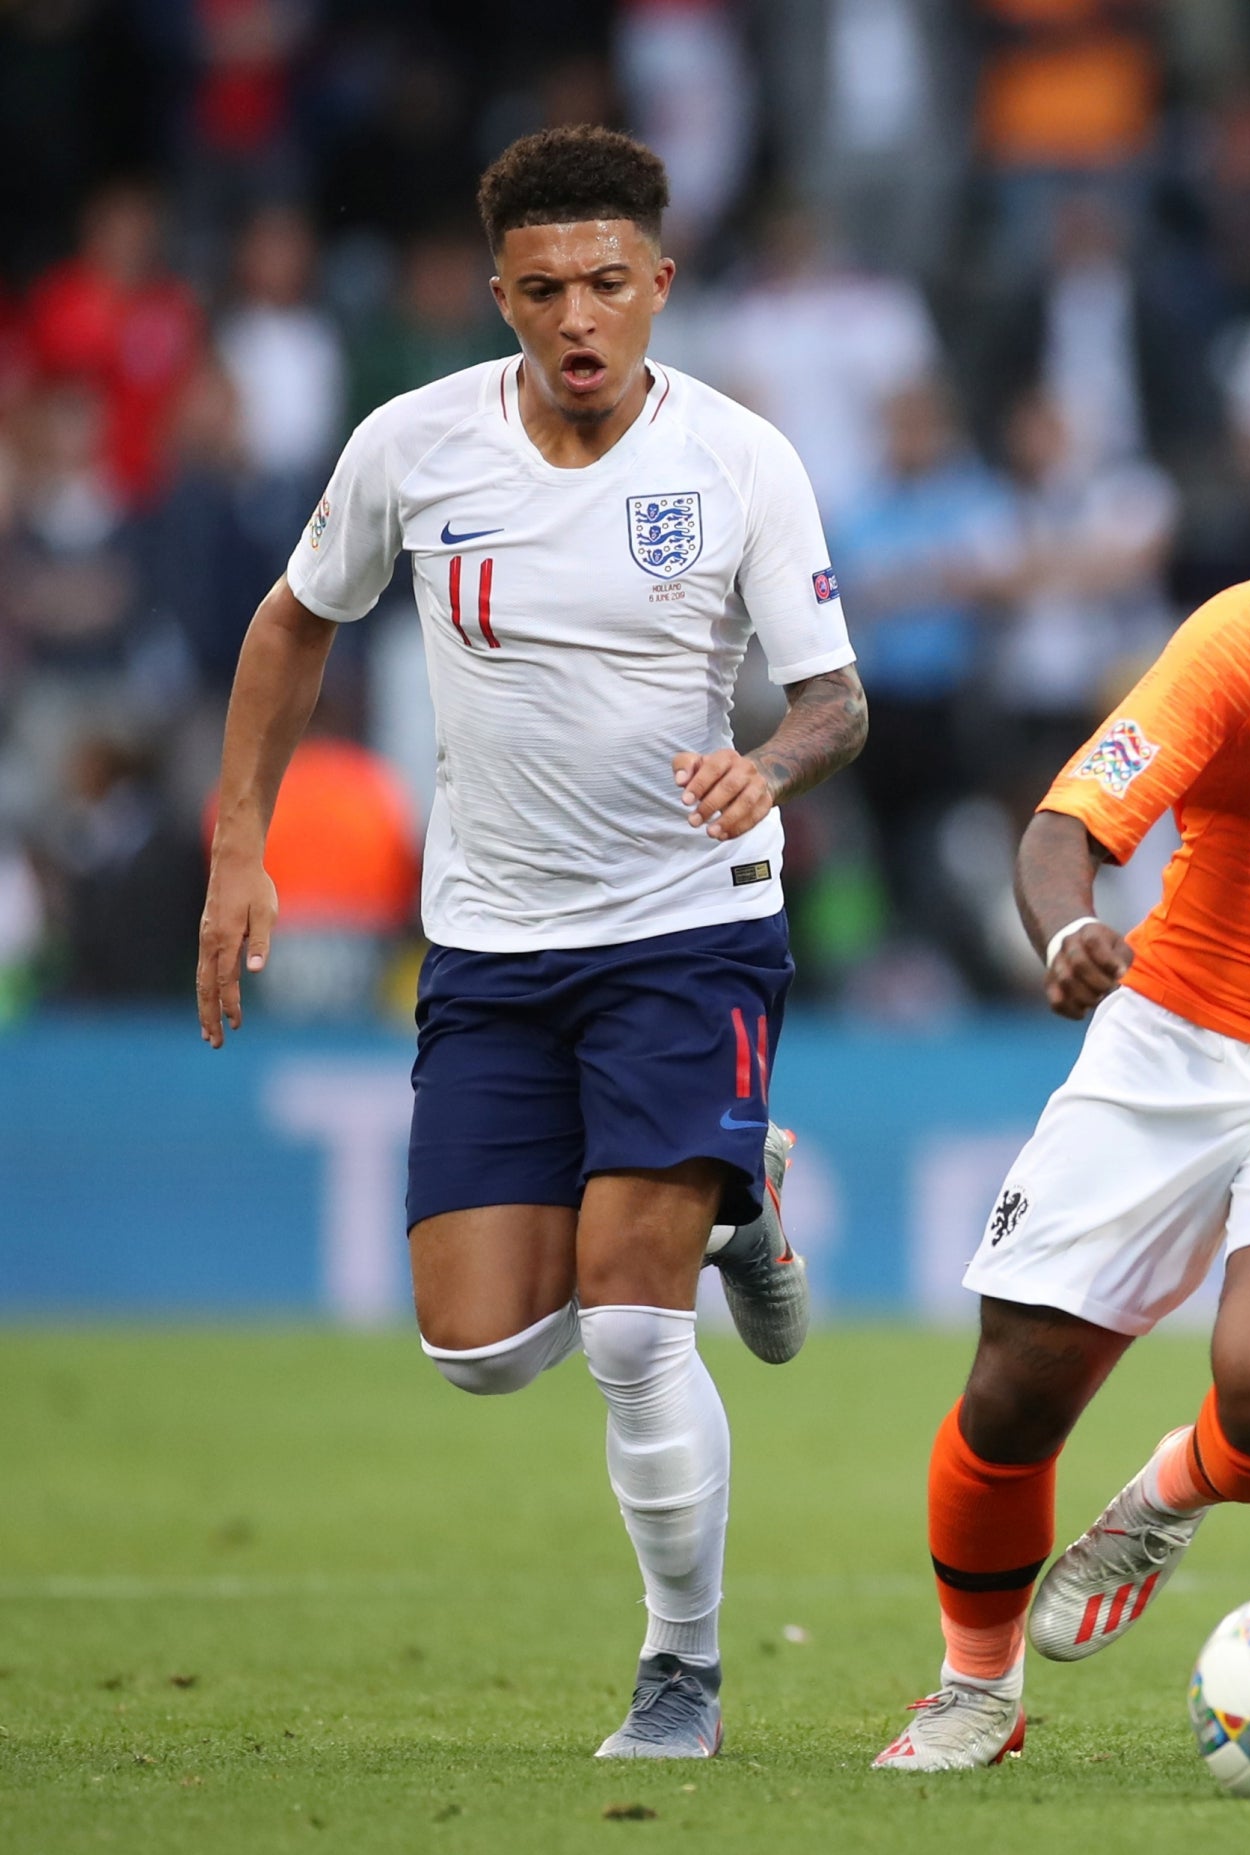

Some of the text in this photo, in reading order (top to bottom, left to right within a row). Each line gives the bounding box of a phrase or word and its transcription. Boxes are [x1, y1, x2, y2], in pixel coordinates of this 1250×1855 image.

[449, 555, 501, 649] 11
[653, 583, 681, 592] HOLLAND
[731, 1007, 768, 1105] 11
